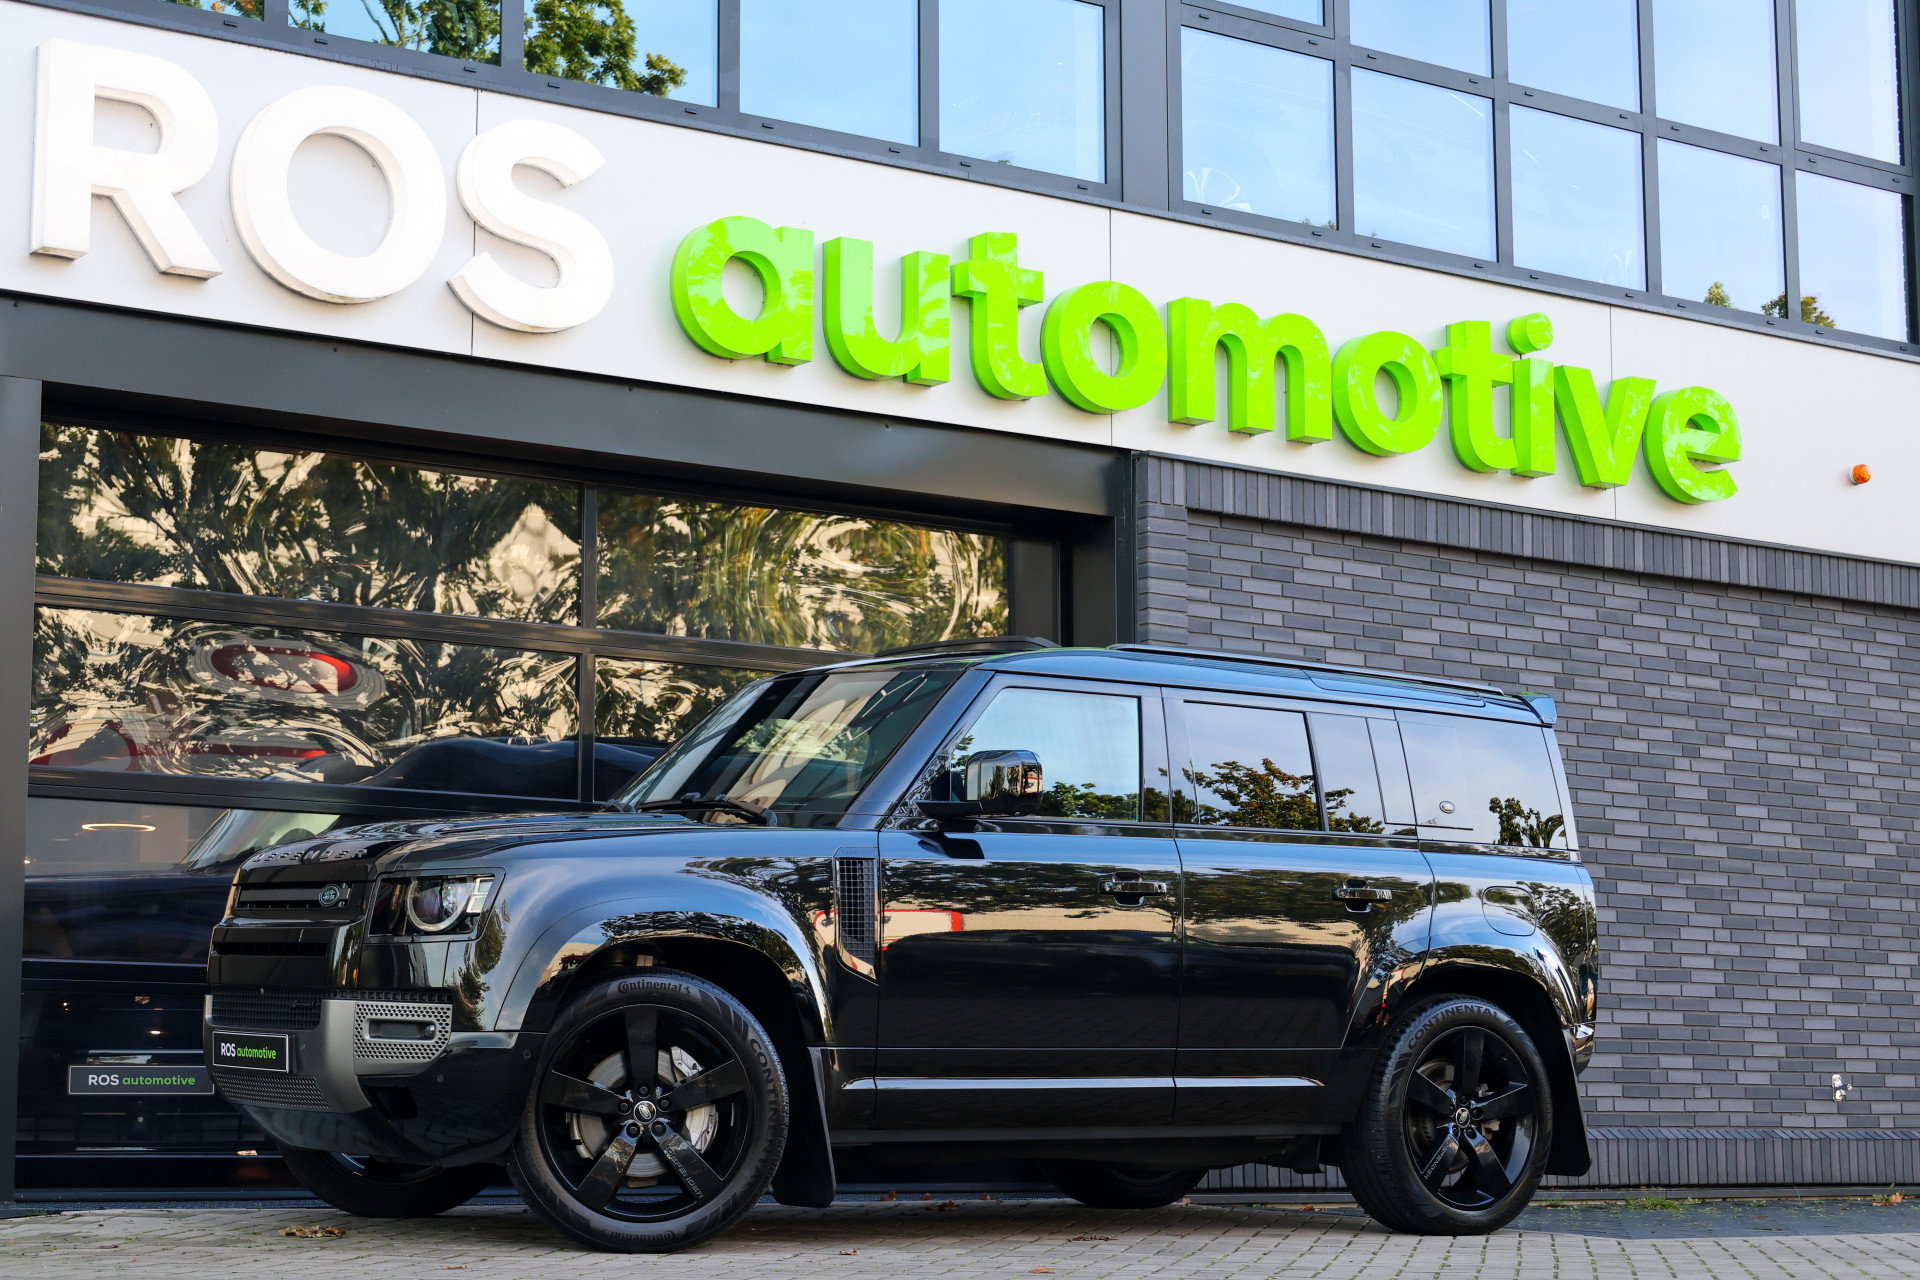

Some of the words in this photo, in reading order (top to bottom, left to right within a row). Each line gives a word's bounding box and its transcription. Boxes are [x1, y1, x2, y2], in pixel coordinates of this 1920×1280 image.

[29, 37, 614, 334] ROS
[670, 215, 1742, 504] automotive
[617, 980, 683, 993] Continental
[1408, 1004, 1500, 1050] CONTINENTAL
[220, 1042, 236, 1058] ROS
[236, 1045, 277, 1060] automotive
[88, 1074, 120, 1086] ROS
[122, 1074, 196, 1086] automotive
